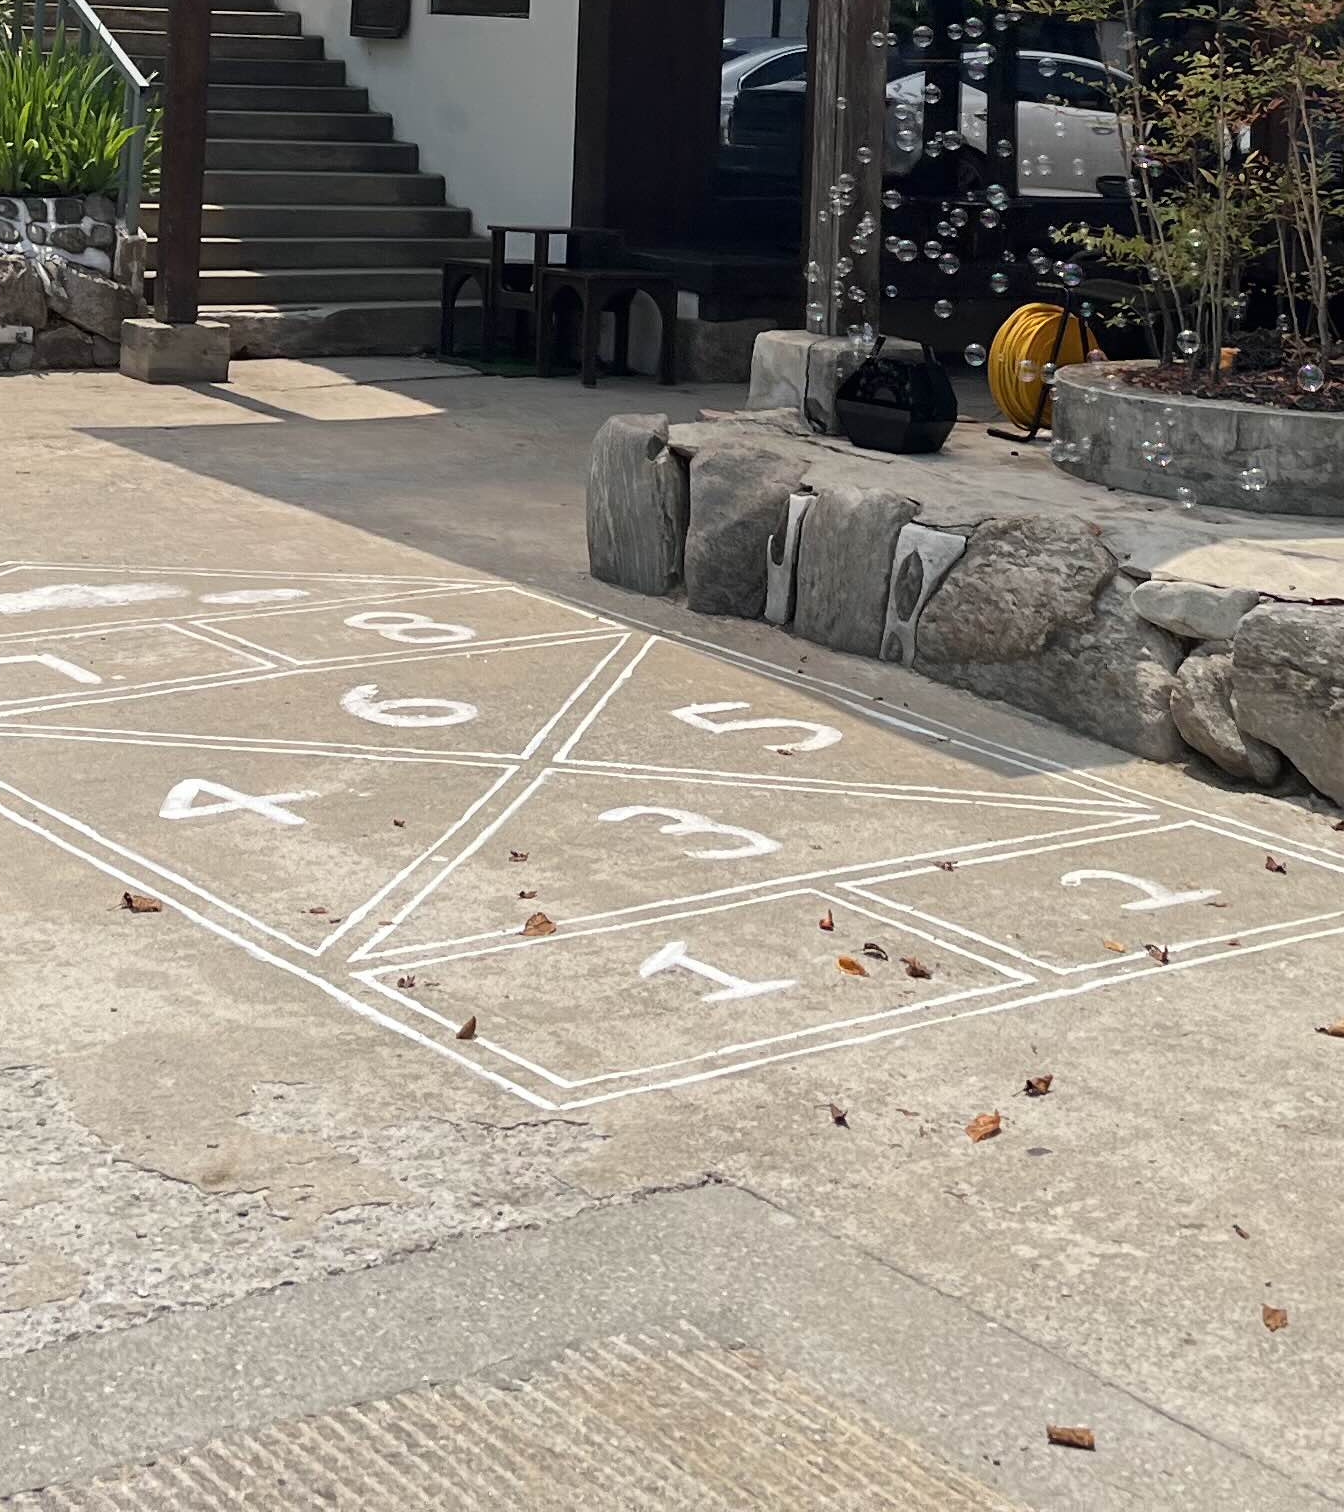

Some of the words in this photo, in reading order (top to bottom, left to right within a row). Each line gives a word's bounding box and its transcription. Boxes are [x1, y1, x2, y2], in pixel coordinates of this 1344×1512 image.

[343, 611, 476, 644] 8
[339, 683, 479, 728] 6
[669, 701, 844, 752] 5
[158, 778, 322, 826] 4
[597, 805, 784, 860] 3
[1060, 869, 1222, 911] 2
[638, 940, 800, 1004] 1
